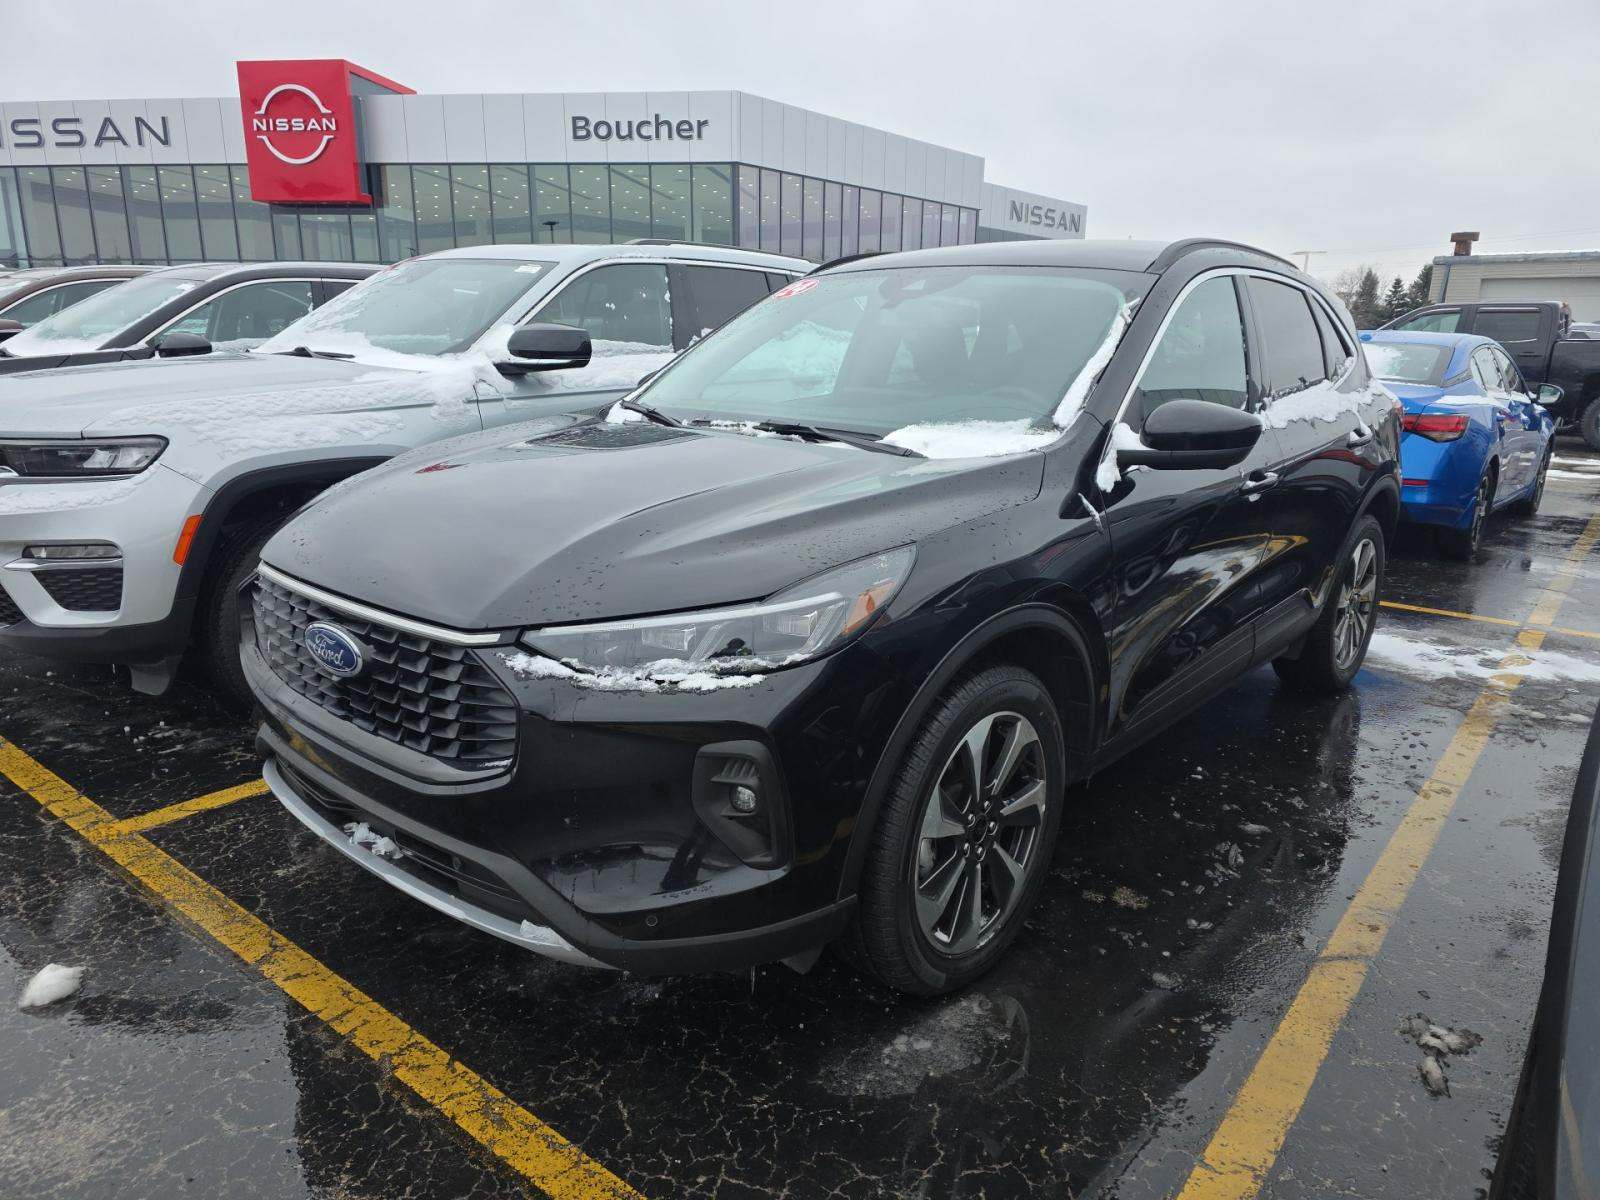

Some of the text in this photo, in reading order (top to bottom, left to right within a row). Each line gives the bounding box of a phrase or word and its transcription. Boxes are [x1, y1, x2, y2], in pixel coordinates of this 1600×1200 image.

[0, 116, 170, 148] SSAN
[252, 117, 337, 132] NISSAN
[571, 113, 709, 140] Boucher
[1009, 200, 1081, 233] NISSAN
[307, 630, 345, 667] Ford
